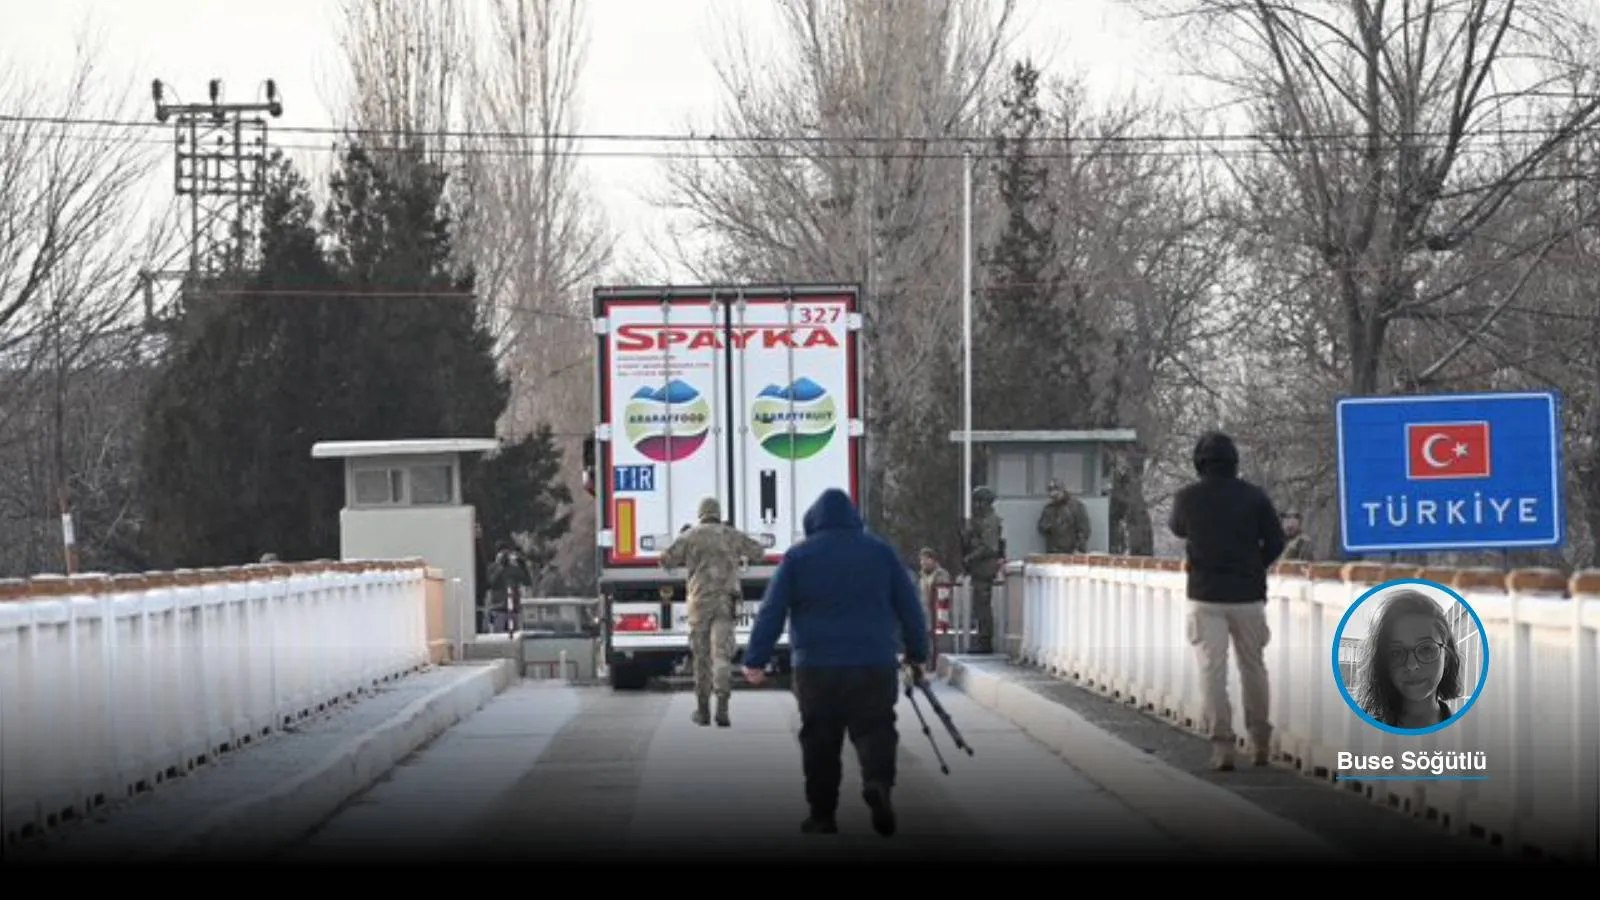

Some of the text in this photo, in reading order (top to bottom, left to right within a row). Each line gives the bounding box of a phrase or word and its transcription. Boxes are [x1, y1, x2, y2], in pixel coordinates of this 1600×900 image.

[800, 307, 841, 324] 327
[616, 323, 839, 351] SPAYKA
[615, 468, 651, 488] TIR
[1362, 491, 1538, 527] TÜRKİYE
